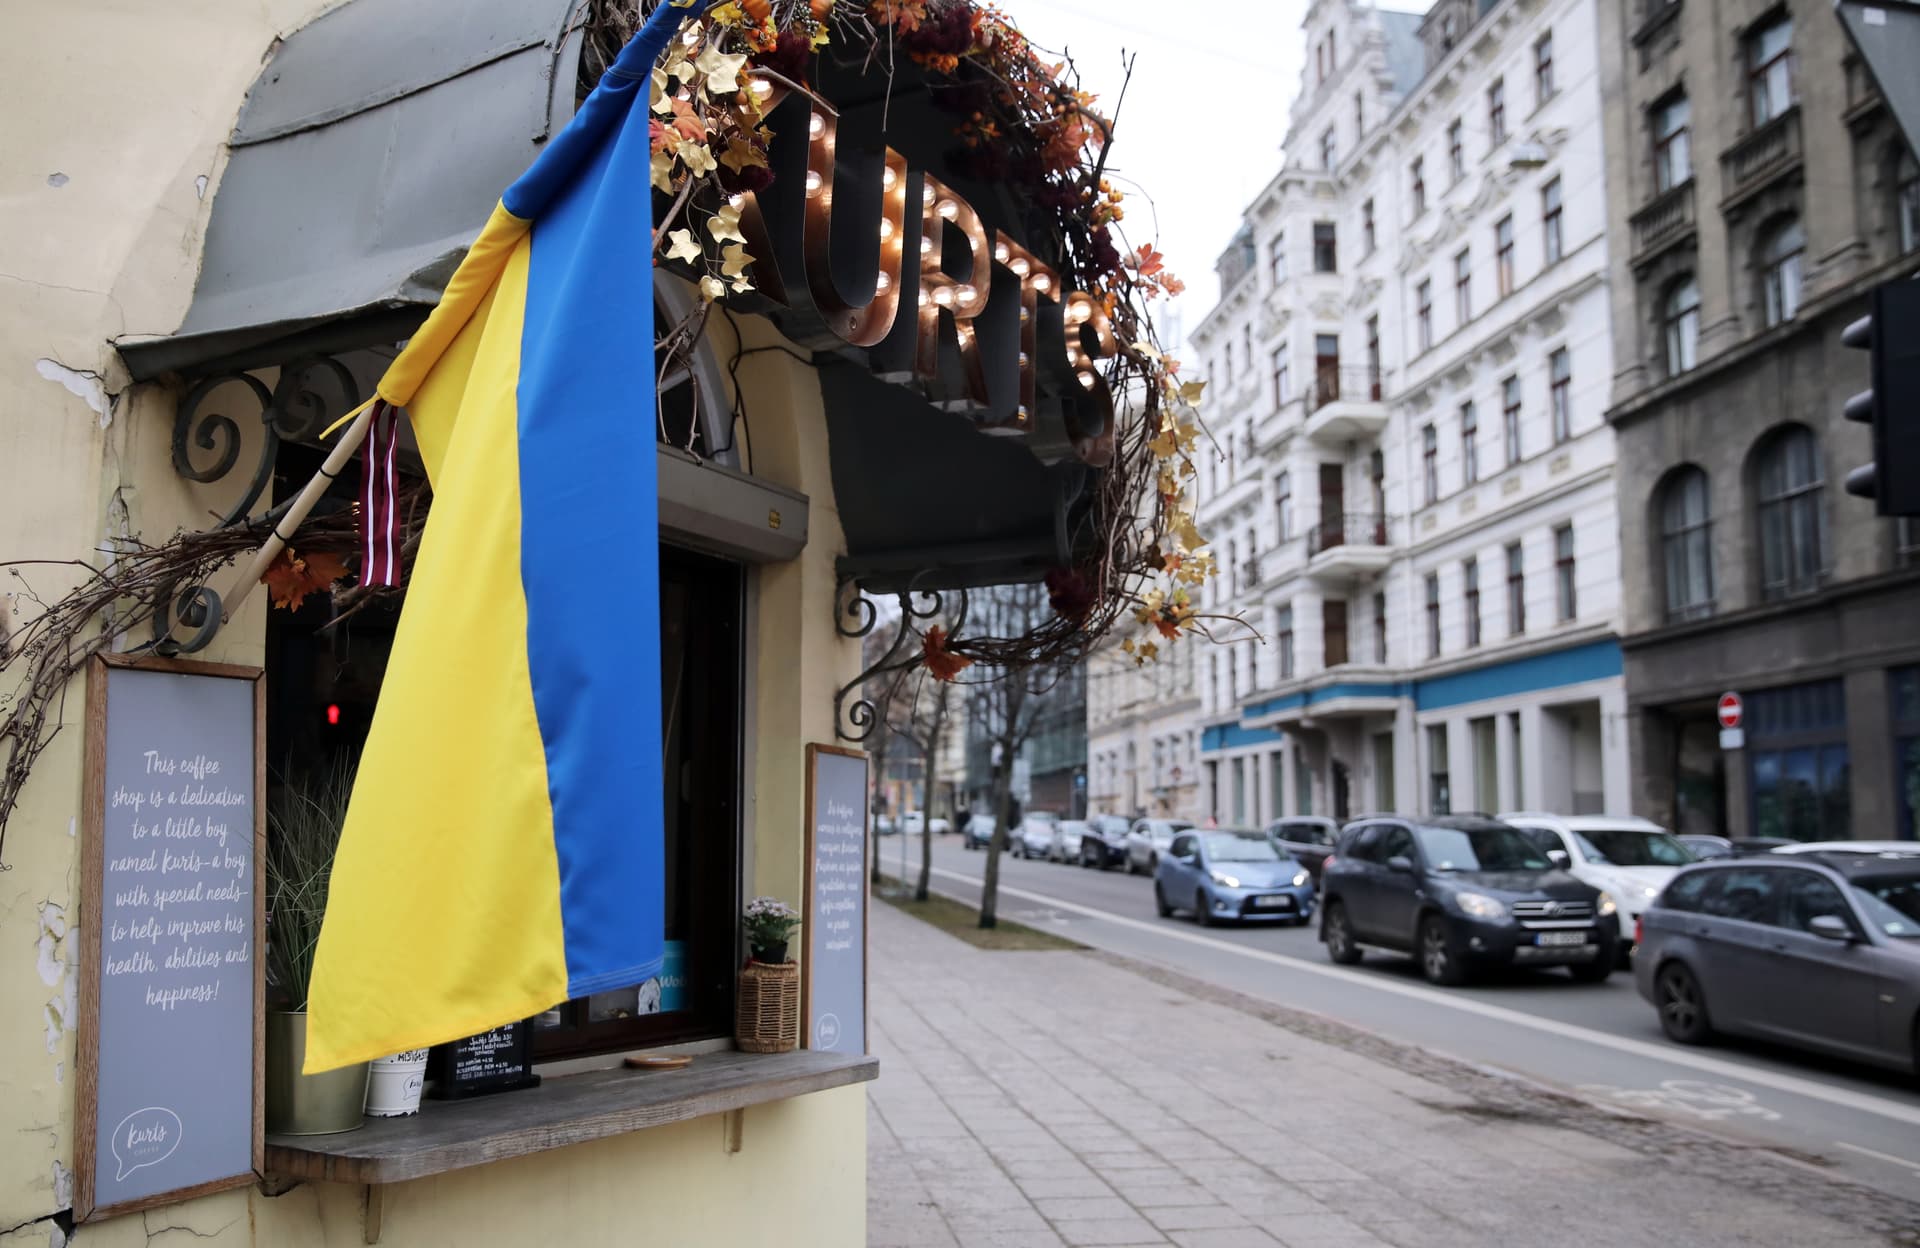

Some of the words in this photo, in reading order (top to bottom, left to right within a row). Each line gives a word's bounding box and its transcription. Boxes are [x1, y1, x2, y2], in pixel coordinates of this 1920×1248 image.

[144, 750, 177, 775] This
[180, 754, 221, 780] coffee
[112, 785, 146, 812] shop
[150, 787, 164, 808] is
[167, 789, 178, 805] a
[180, 784, 246, 806] dedication
[131, 818, 148, 840] to
[151, 822, 161, 837] a
[165, 817, 202, 839] little
[206, 816, 228, 847] boy
[110, 849, 157, 872] named
[224, 848, 247, 877] boy
[115, 884, 150, 907] with
[153, 881, 203, 911] special
[110, 919, 127, 942] to
[129, 916, 163, 944] help
[167, 918, 221, 942] improve
[224, 913, 246, 934] his
[105, 951, 159, 976] health,
[164, 947, 221, 970] abilities
[225, 942, 248, 964] and
[145, 980, 220, 1010] happiness!
